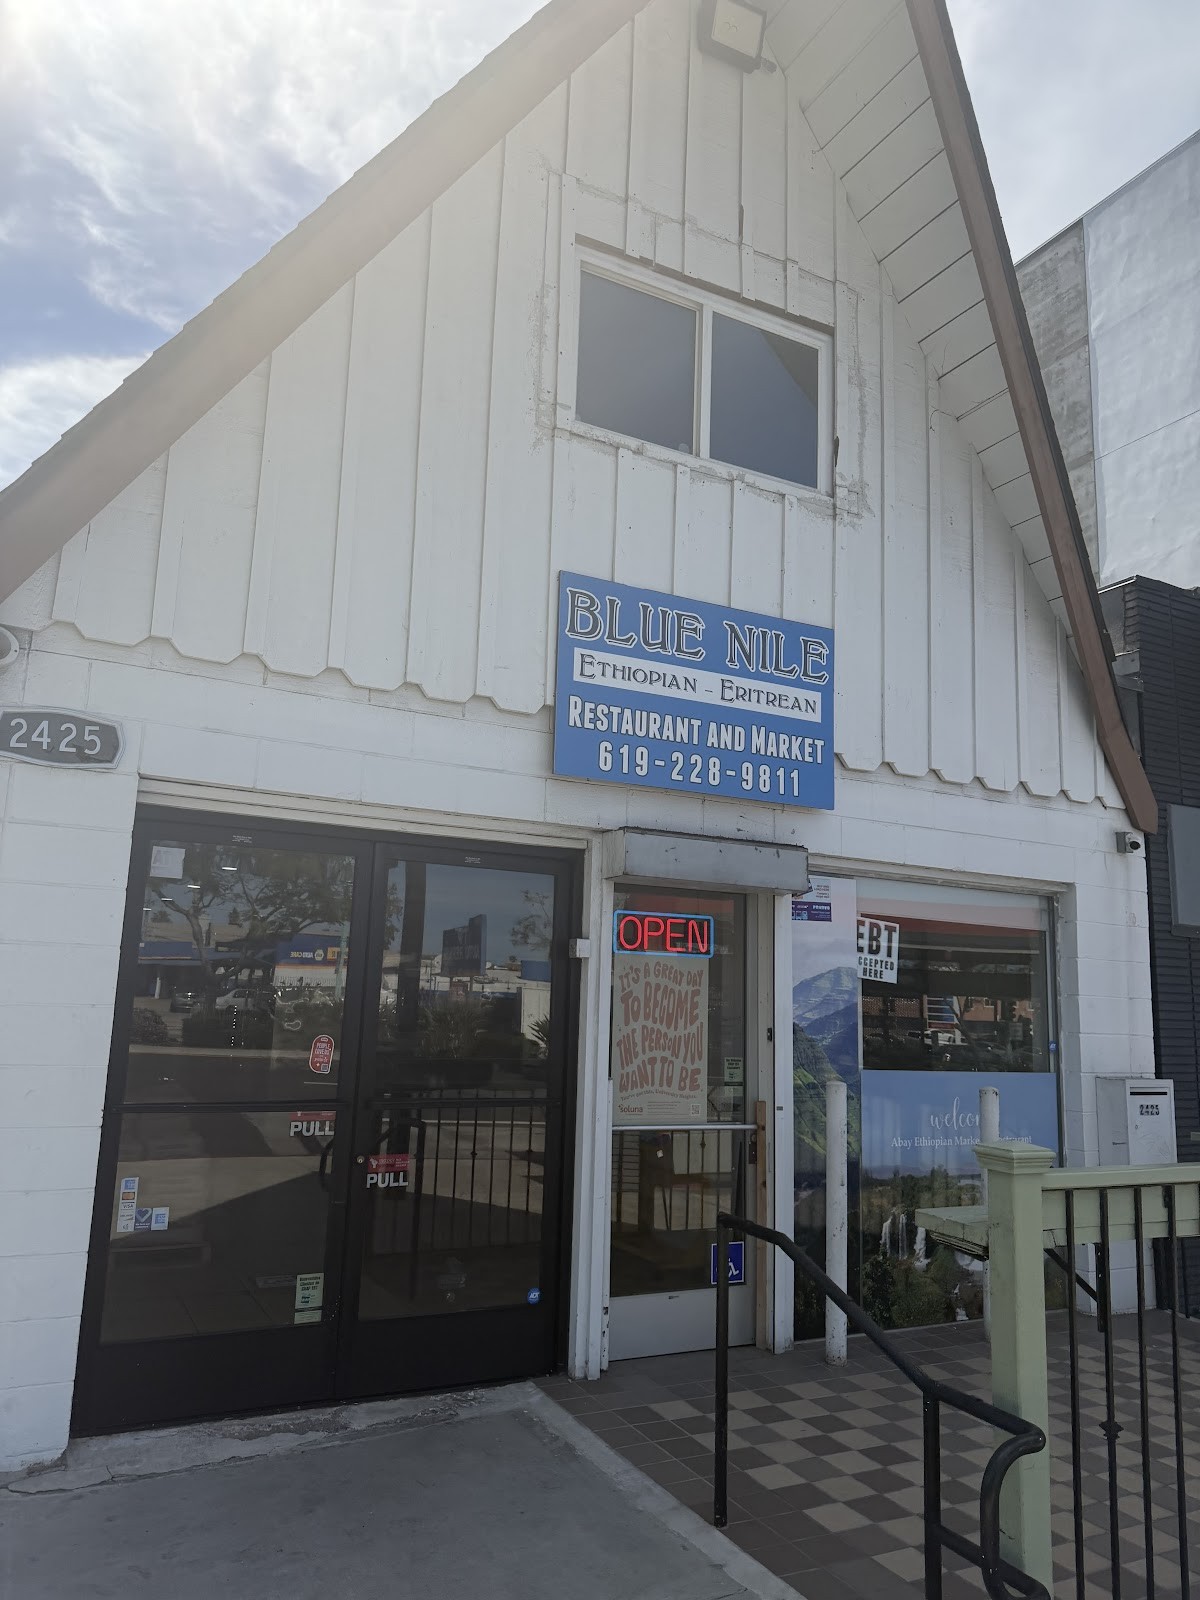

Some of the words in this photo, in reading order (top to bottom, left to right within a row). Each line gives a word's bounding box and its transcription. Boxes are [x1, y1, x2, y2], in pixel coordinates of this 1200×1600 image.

[565, 587, 705, 660] BLUE
[723, 620, 829, 685] NILE
[579, 653, 697, 694] ETHIOPIAN
[720, 678, 817, 715] ERITREAN
[10, 718, 101, 754] 2425
[568, 695, 701, 745] RESTAURANT
[707, 722, 745, 752] AND
[752, 725, 824, 764] MARKET
[599, 741, 799, 797] 619-228-9811
[619, 916, 708, 953] OPEN
[857, 919, 897, 958] EBT
[619, 965, 641, 993] IT'S
[643, 962, 650, 979] A
[653, 961, 685, 985] GREAT
[686, 969, 703, 988] DAY
[858, 956, 895, 971] CCEPTED
[862, 967, 884, 979] HERE
[620, 990, 641, 1026] TO
[643, 981, 700, 1031] BECOME
[616, 1028, 638, 1070] THE
[641, 1024, 682, 1059] PERSON
[683, 1021, 703, 1065] YOU
[619, 1057, 657, 1093] WANT
[659, 1057, 675, 1088] TO
[619, 1103, 643, 1113] soluna
[930, 1096, 980, 1131] welco
[290, 1121, 335, 1137] PULL
[891, 1137, 912, 1150] Abay
[915, 1136, 953, 1149] Ethiopian
[954, 1136, 980, 1146] Marke
[366, 1171, 409, 1188] PULL
